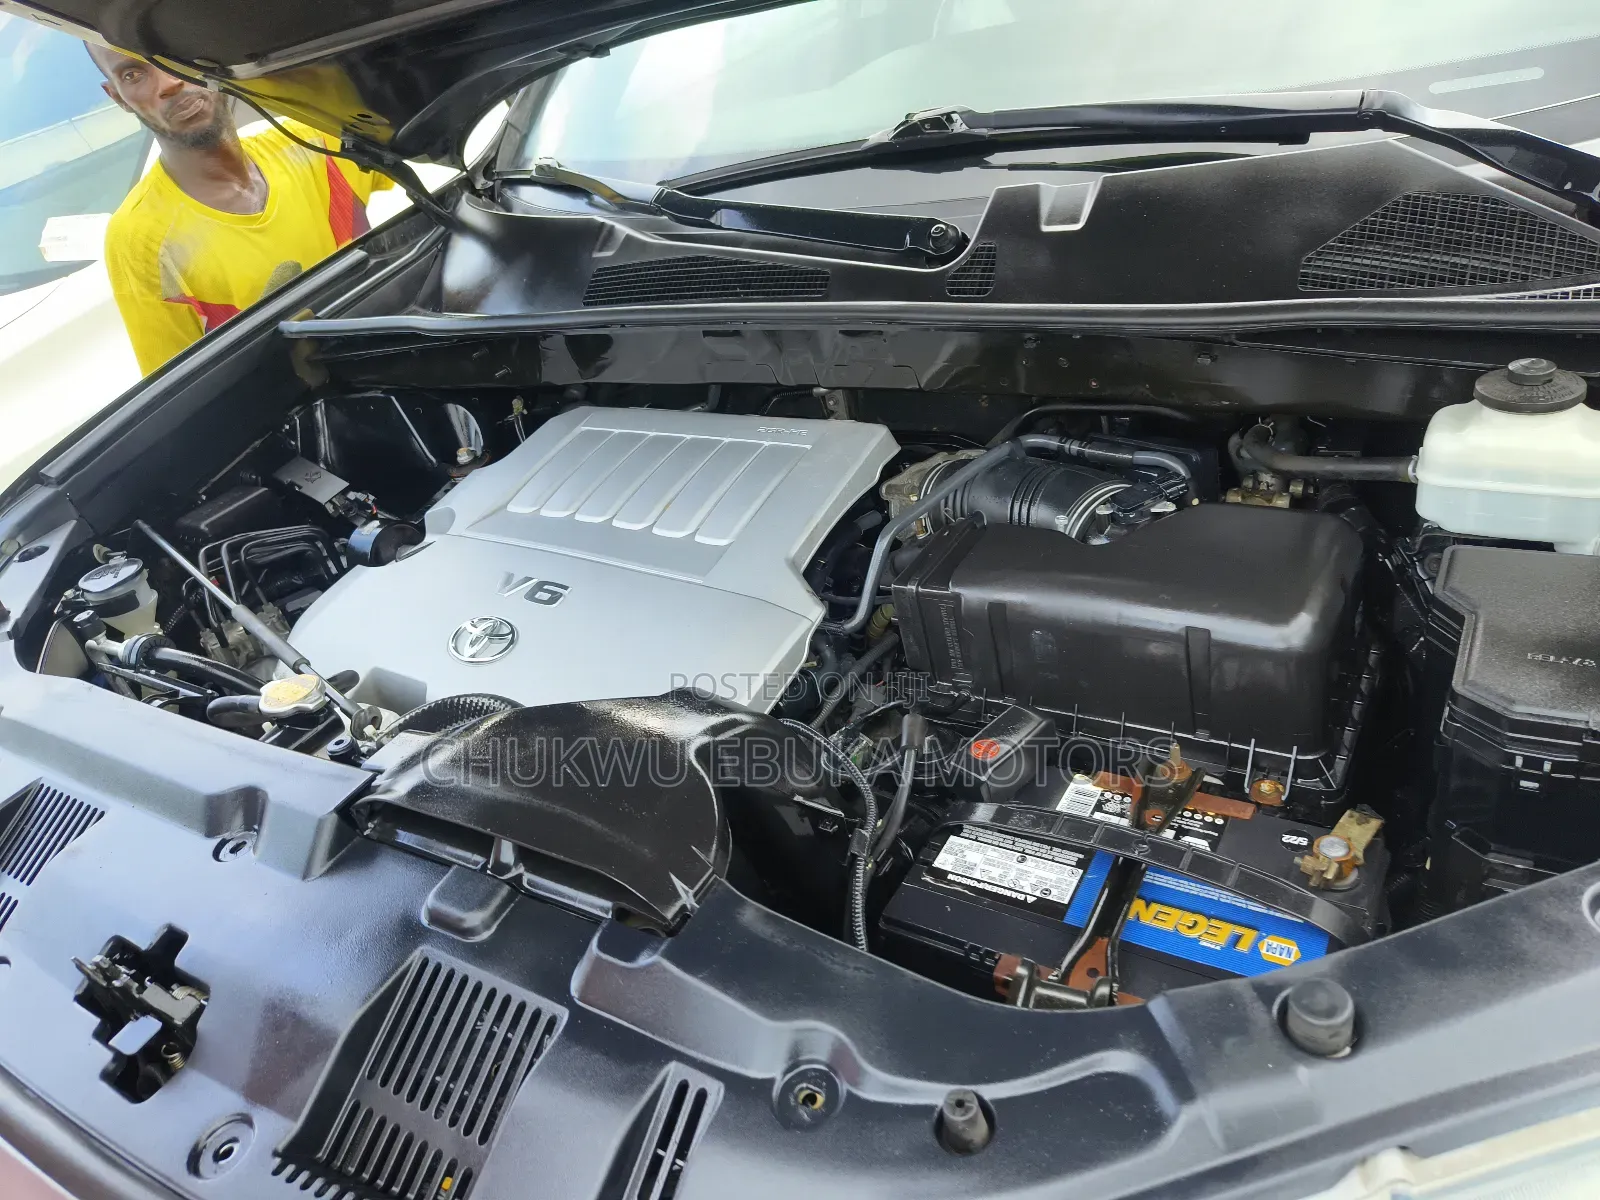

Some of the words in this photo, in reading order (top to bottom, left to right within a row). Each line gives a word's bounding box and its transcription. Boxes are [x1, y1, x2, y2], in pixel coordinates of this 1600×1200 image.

[495, 571, 572, 607] V6
[947, 873, 1026, 901] DANGER/POISON
[1128, 898, 1258, 953] LEGEN
[1265, 941, 1295, 959] NAPA
